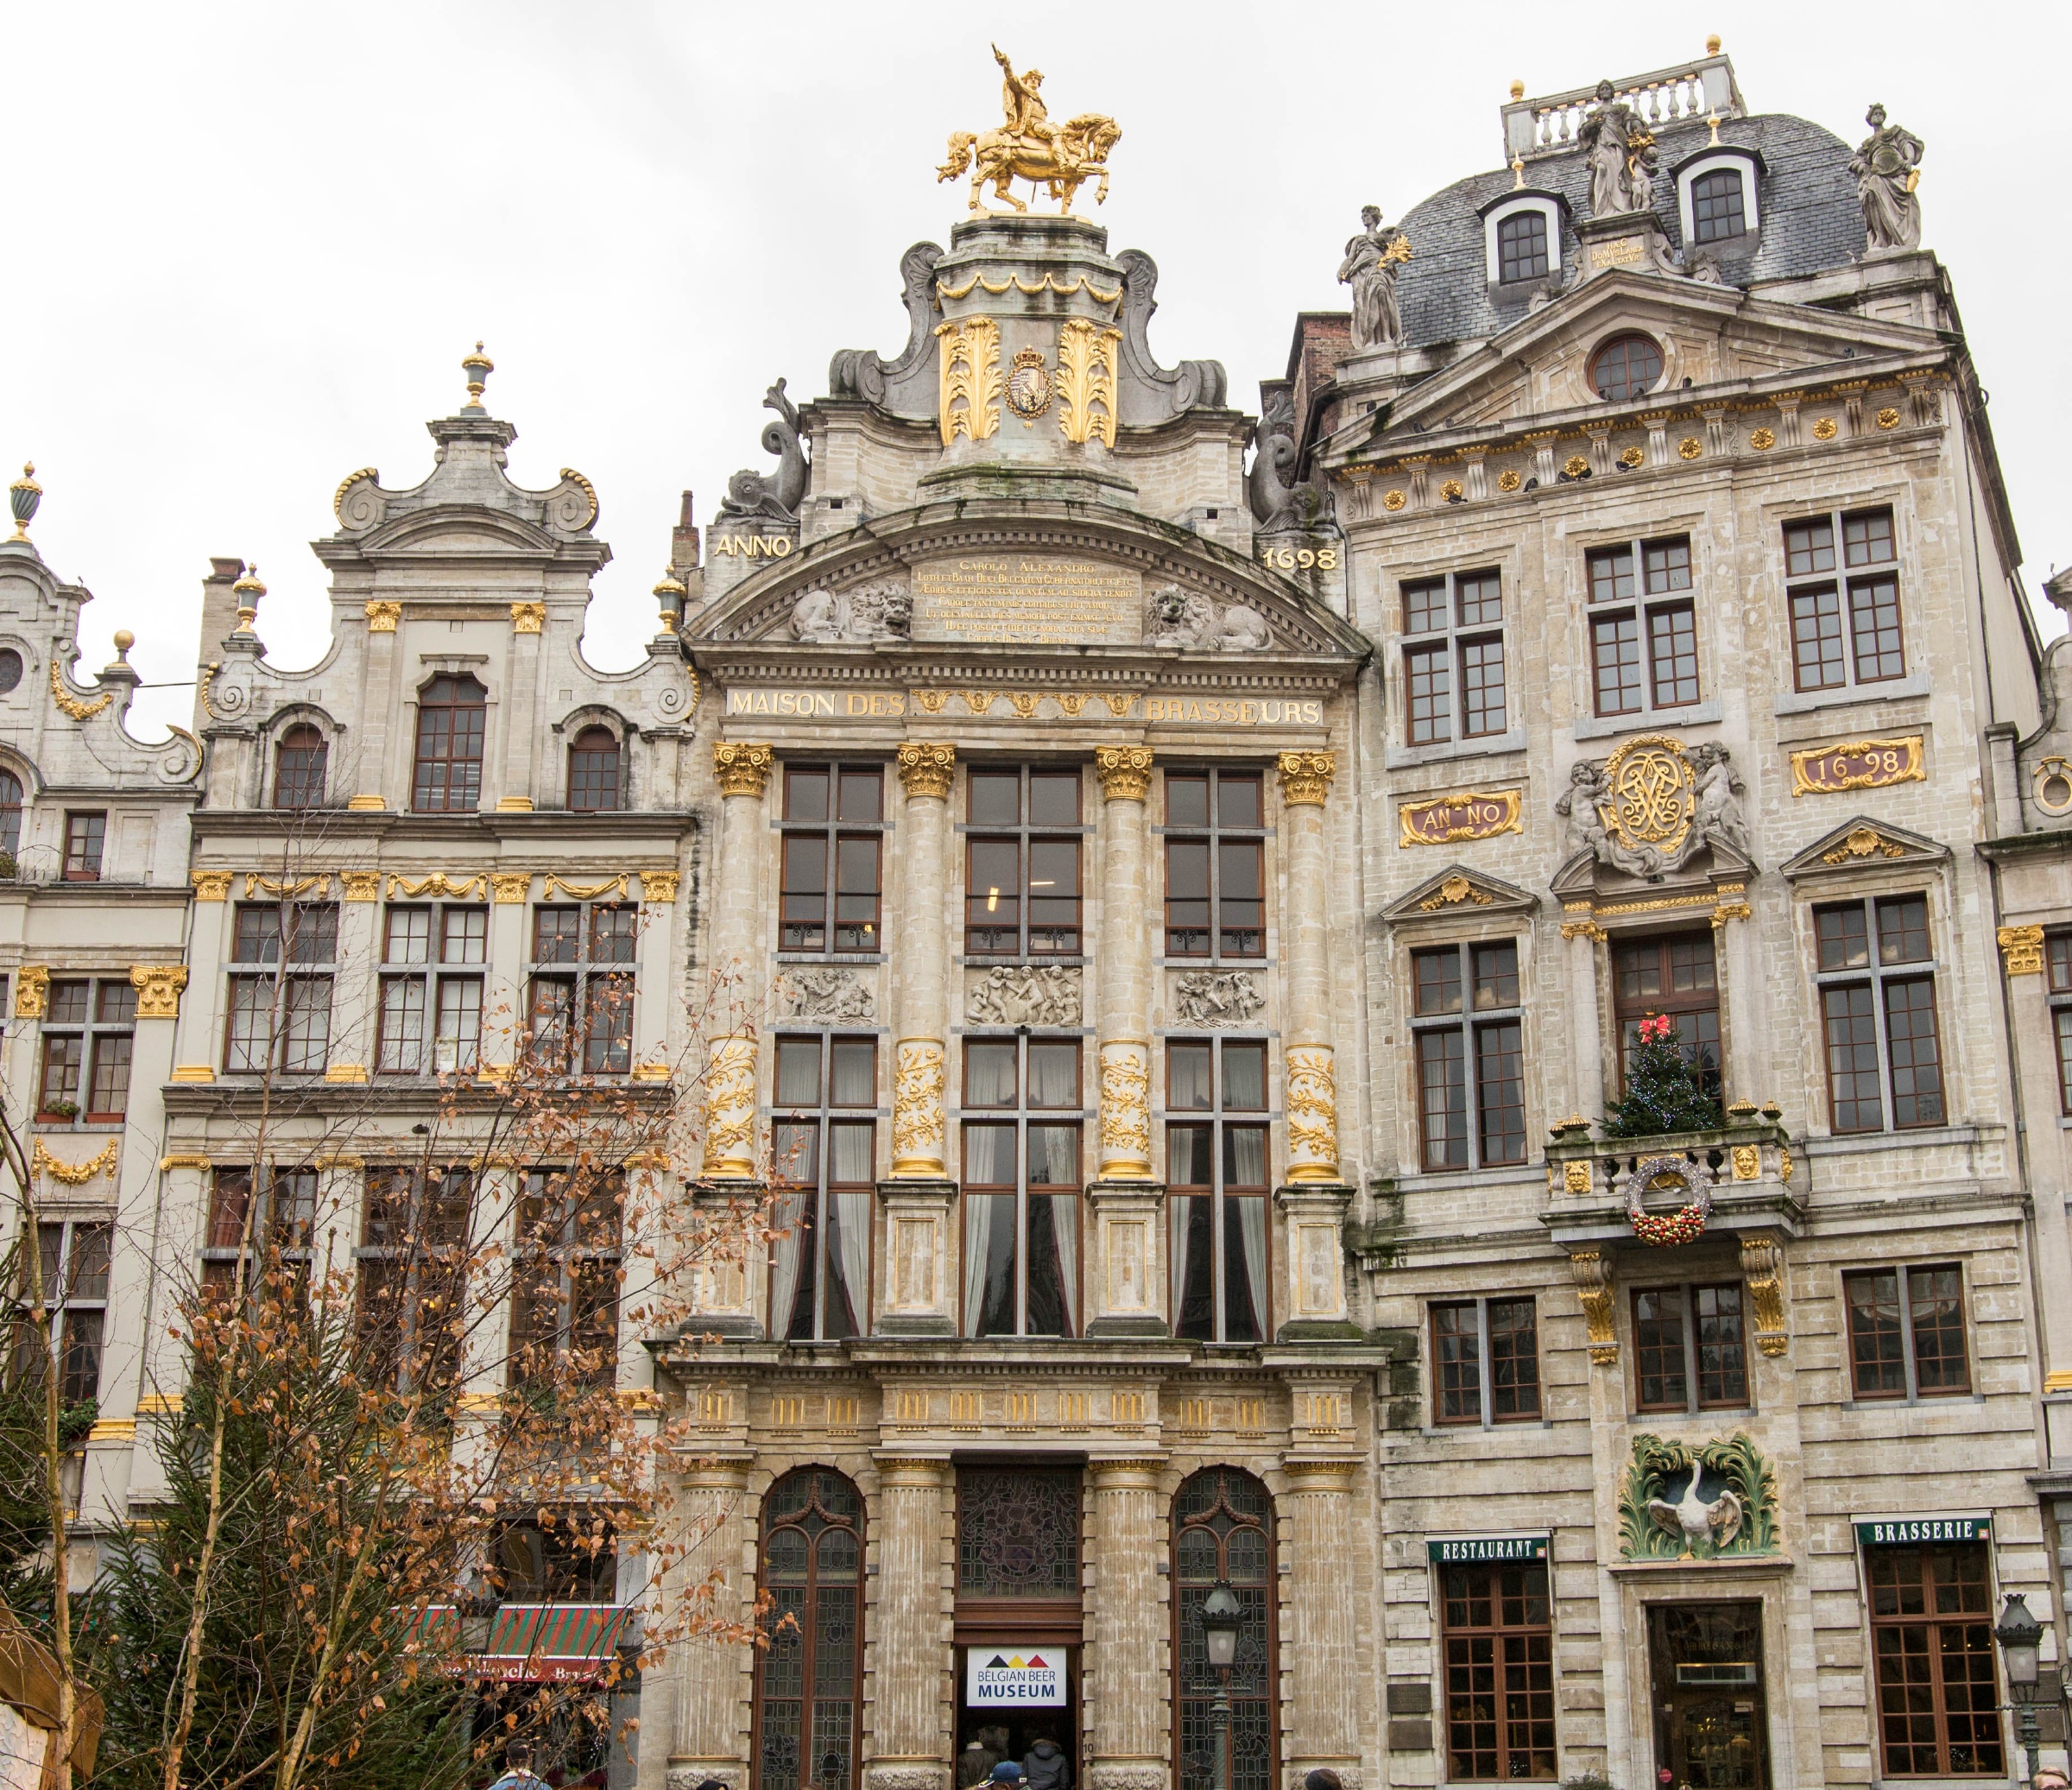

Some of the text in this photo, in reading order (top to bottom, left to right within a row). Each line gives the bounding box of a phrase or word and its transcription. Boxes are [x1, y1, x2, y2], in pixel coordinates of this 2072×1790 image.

[715, 534, 792, 558] ANNO
[960, 560, 1095, 573] CAROLO ALEXANDRO
[1263, 547, 1337, 571] 1698
[918, 572, 939, 582] LOTH
[732, 687, 906, 717] MAISON DES
[1146, 698, 1321, 725] BRASSEURS
[1873, 1521, 1974, 1542] BRASSERIE
[1443, 1540, 1532, 1559] RESTAURANT
[977, 1671, 1056, 1682] BELGIAN BEER
[978, 1684, 1055, 1698] MUSEUM
